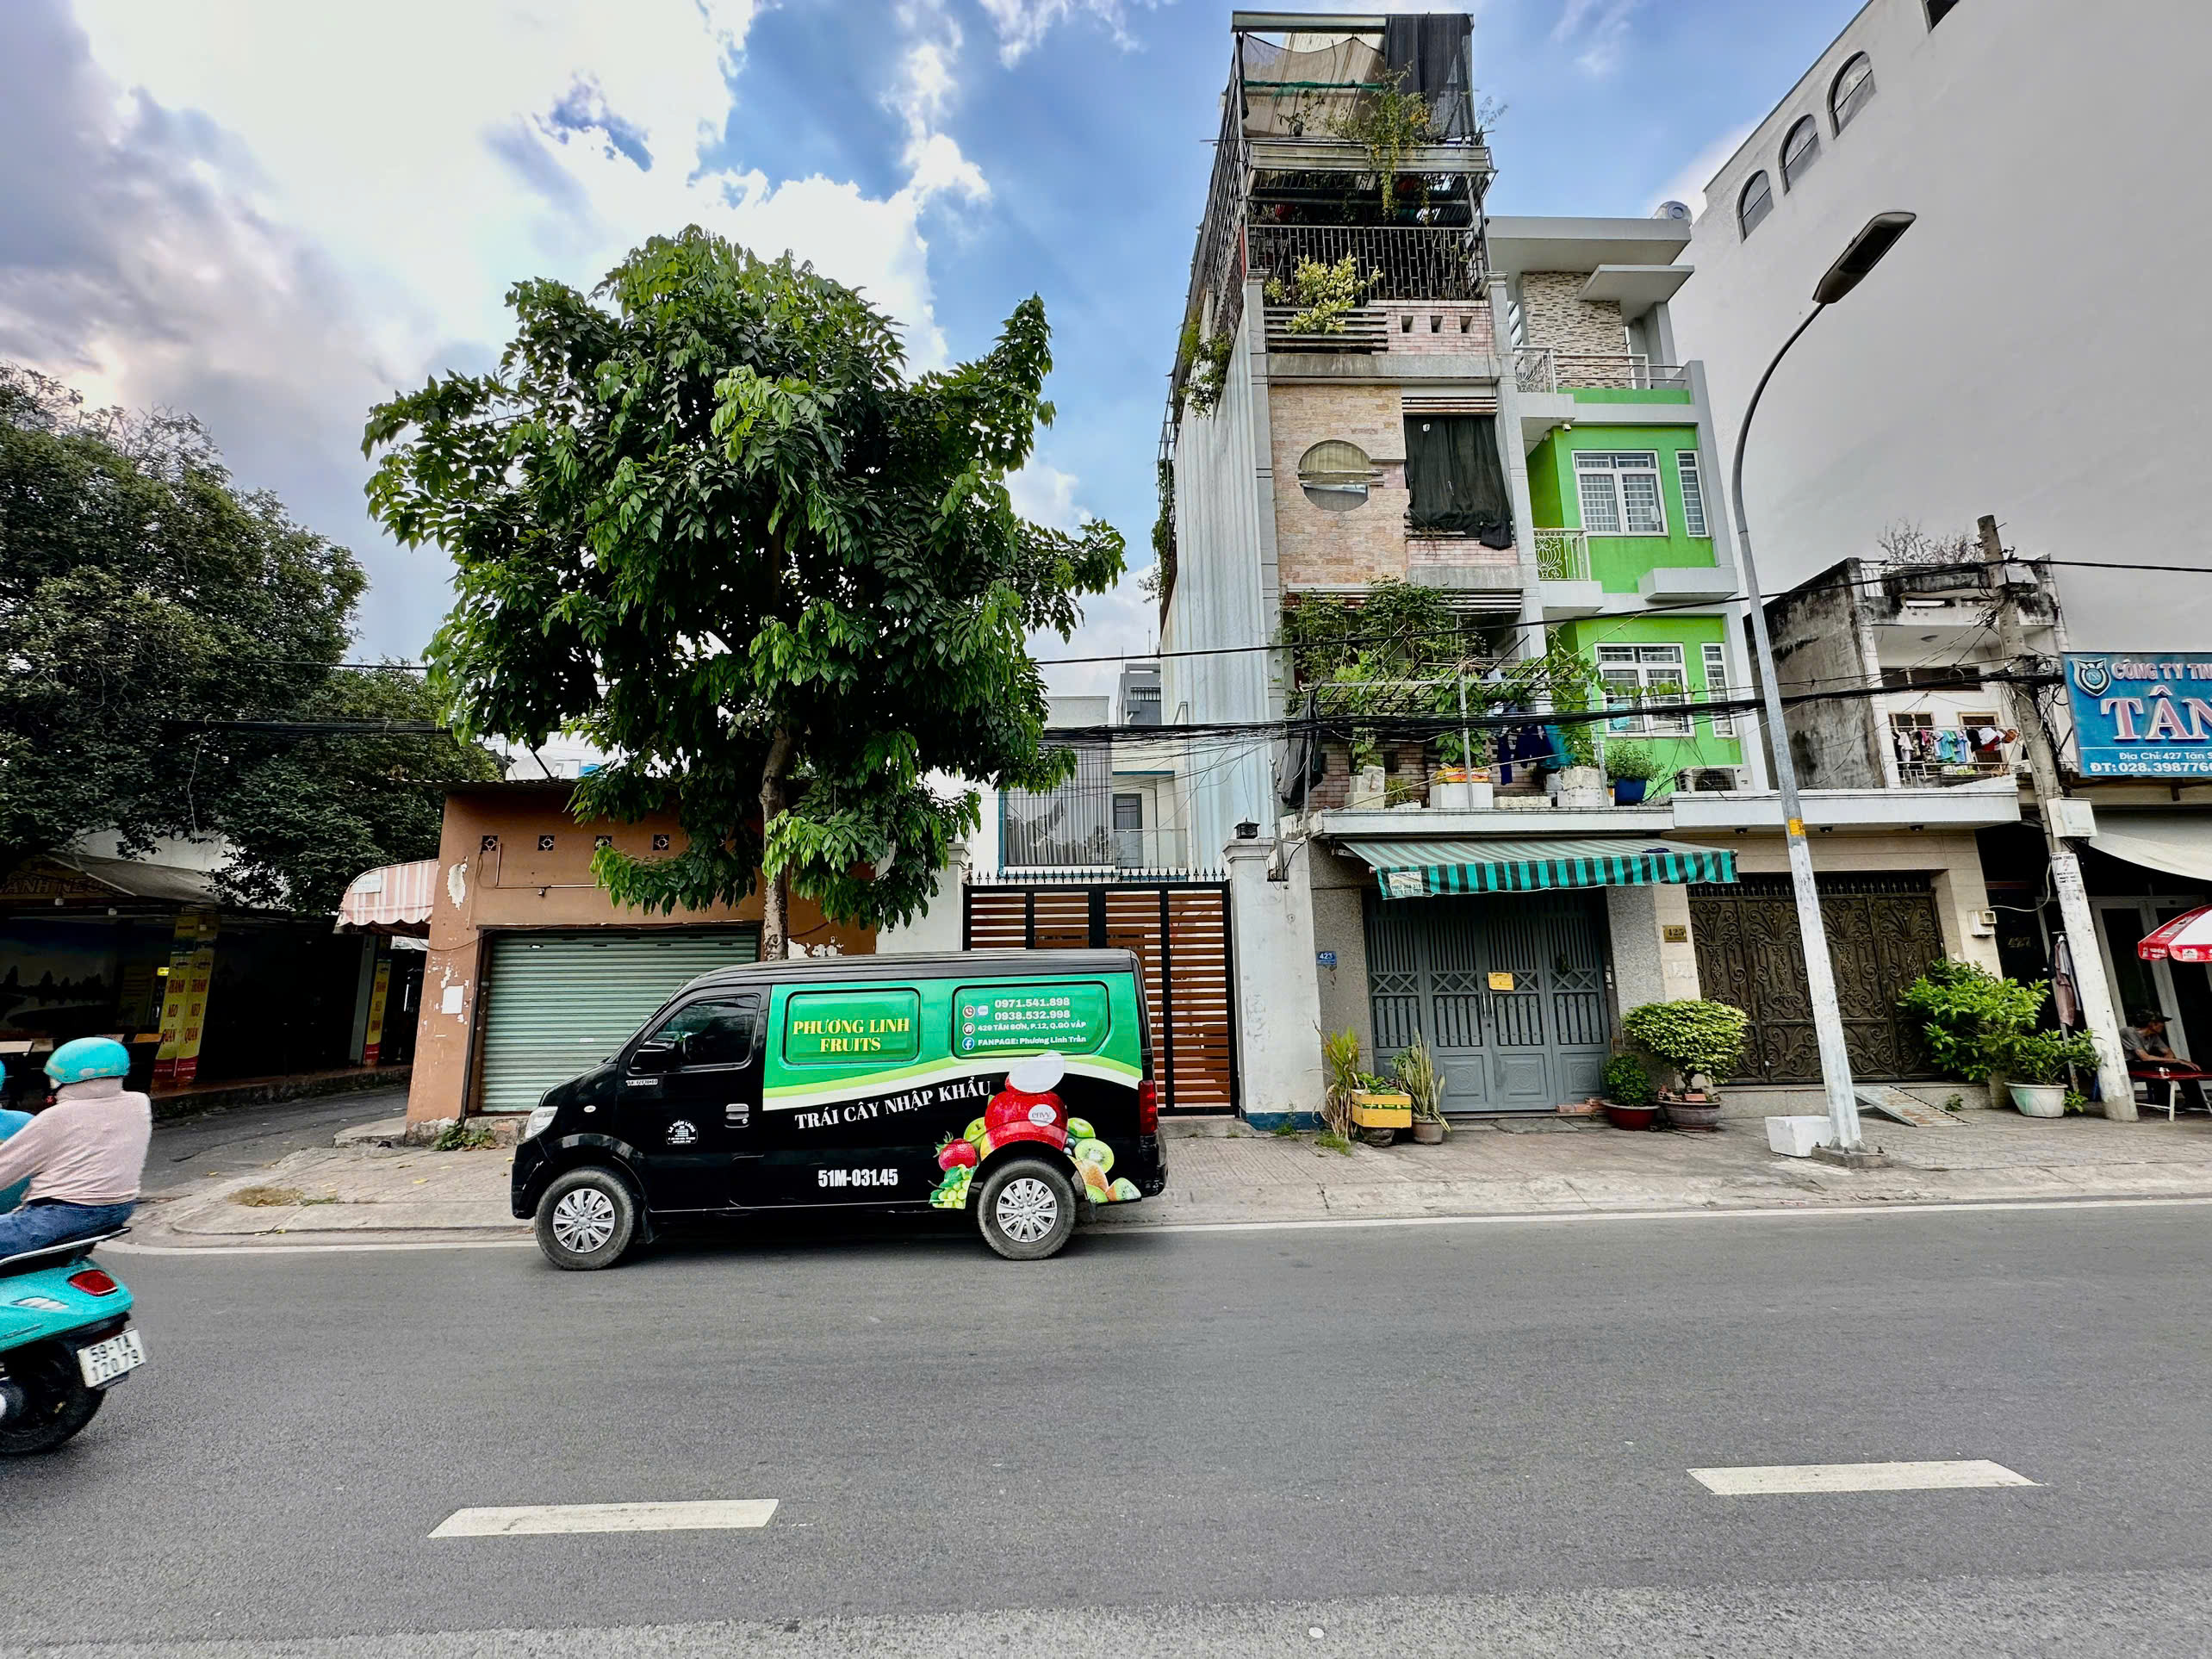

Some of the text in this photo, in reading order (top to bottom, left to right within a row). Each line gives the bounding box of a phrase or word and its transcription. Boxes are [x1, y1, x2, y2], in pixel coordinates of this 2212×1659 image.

[2111, 658, 2158, 680] CÔNG
[2159, 662, 2184, 680] TY
[2100, 685, 2212, 740] TÂN
[2090, 762, 2116, 773] ĐT:
[2118, 761, 2151, 773] 028.
[994, 997, 1071, 1009] 0971.541.898
[994, 1010, 1072, 1021] 0938.532.998
[792, 1018, 910, 1035] PHƯƠNG LINH
[993, 1022, 1009, 1031] TÂN
[1030, 1022, 1048, 1031] P.12,
[1050, 1020, 1070, 1029] Q.GÒ
[820, 1037, 881, 1052] FRUITS
[1019, 1036, 1049, 1045] Phương
[794, 1077, 991, 1129] TRÁI CÂY NHẬP KHẨU
[817, 1169, 898, 1187] 51M-031.45
